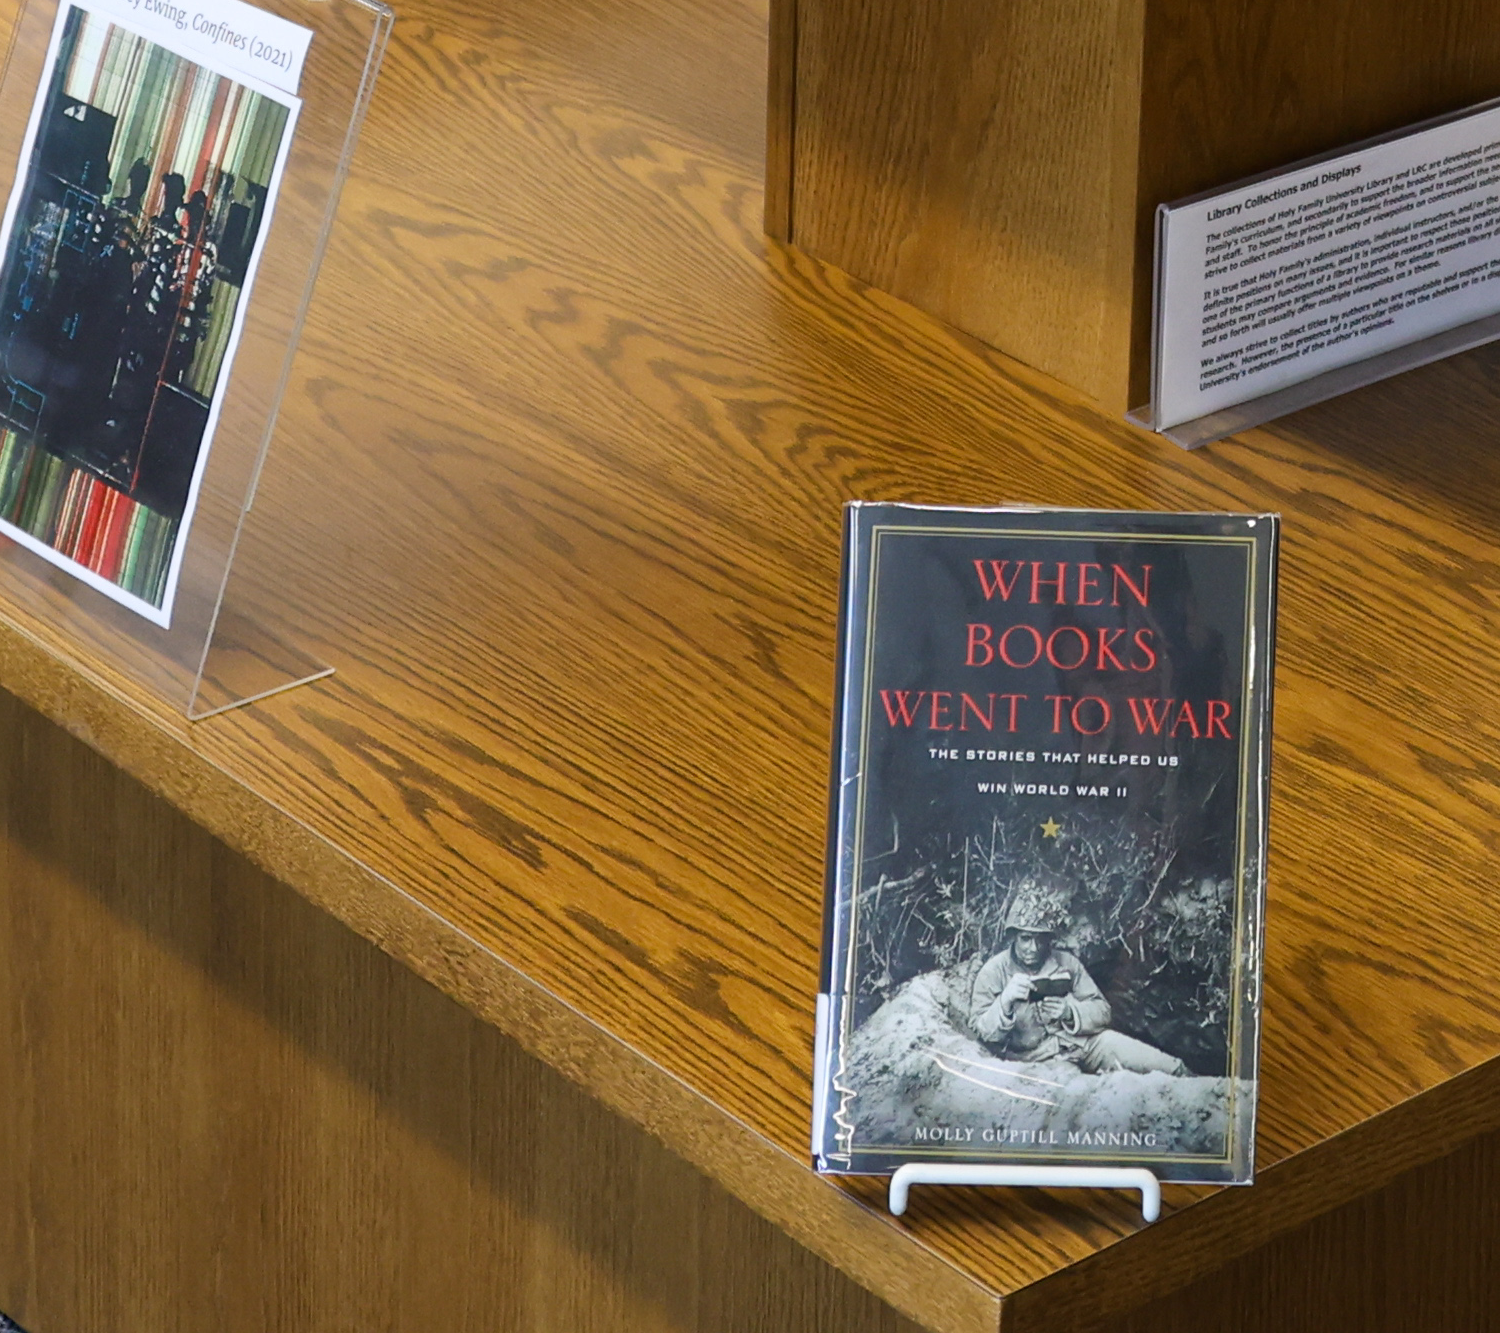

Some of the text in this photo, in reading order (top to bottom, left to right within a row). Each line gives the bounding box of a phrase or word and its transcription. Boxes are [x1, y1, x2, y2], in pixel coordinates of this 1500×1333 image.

[192, 13, 248, 50] Confines
[249, 36, 293, 72] (2021)
[1206, 232, 1221, 242] The
[1223, 218, 1266, 237] collections
[1277, 208, 1295, 220] Holy
[1298, 198, 1323, 213] Family
[1325, 185, 1364, 203] University
[1366, 175, 1393, 190] Library
[1395, 169, 1410, 180] and
[1411, 163, 1426, 175] LRC
[1207, 164, 1361, 222] Library Collections and Displays
[1205, 238, 1238, 255] Family's
[1240, 224, 1284, 243] curriculum,
[1287, 215, 1302, 228] and
[1304, 202, 1348, 222] secondarily
[1360, 187, 1390, 203] support
[1391, 183, 1404, 193] the
[1205, 254, 1220, 266] and
[1222, 247, 1242, 261] staff.
[1259, 235, 1282, 249] honor
[1284, 230, 1298, 240] the
[1299, 218, 1334, 237] principle
[1345, 202, 1381, 220] academic
[1383, 191, 1417, 207] freedom,
[973, 560, 1152, 607] WHEN
[965, 623, 1156, 672] BOOKS
[879, 690, 1233, 740] WENT TO WAR
[929, 748, 1178, 767] THE STORIES THAT HELPED US
[978, 783, 1127, 798] WIN WORLD WAR II
[914, 1127, 1156, 1147] MOLLY GUPTILL MANNING
